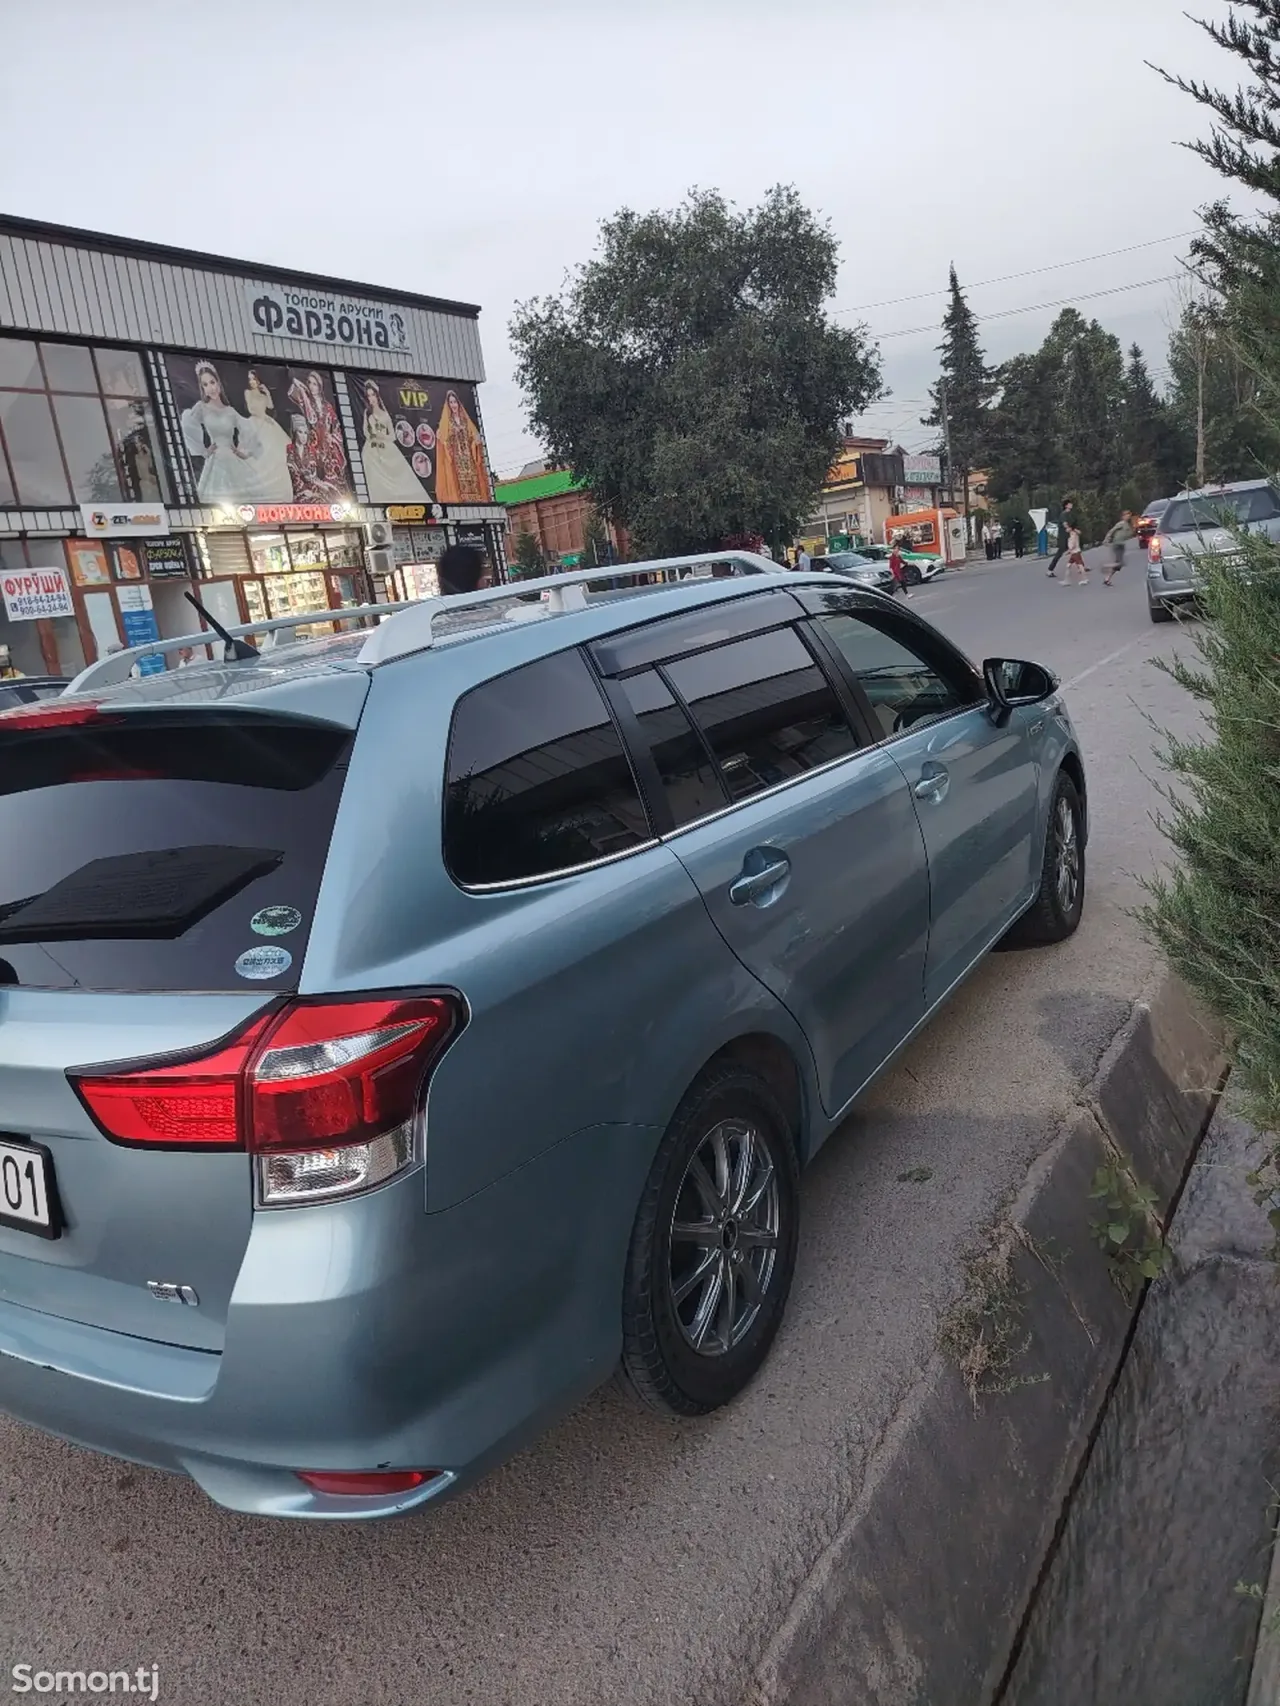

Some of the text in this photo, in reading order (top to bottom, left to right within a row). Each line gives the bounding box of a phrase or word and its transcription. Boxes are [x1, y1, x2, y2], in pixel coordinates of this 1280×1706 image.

[284, 293, 335, 312] ТОЛОРИ
[400, 390, 429, 408] VIP
[257, 505, 333, 523] ДОРУХОНА
